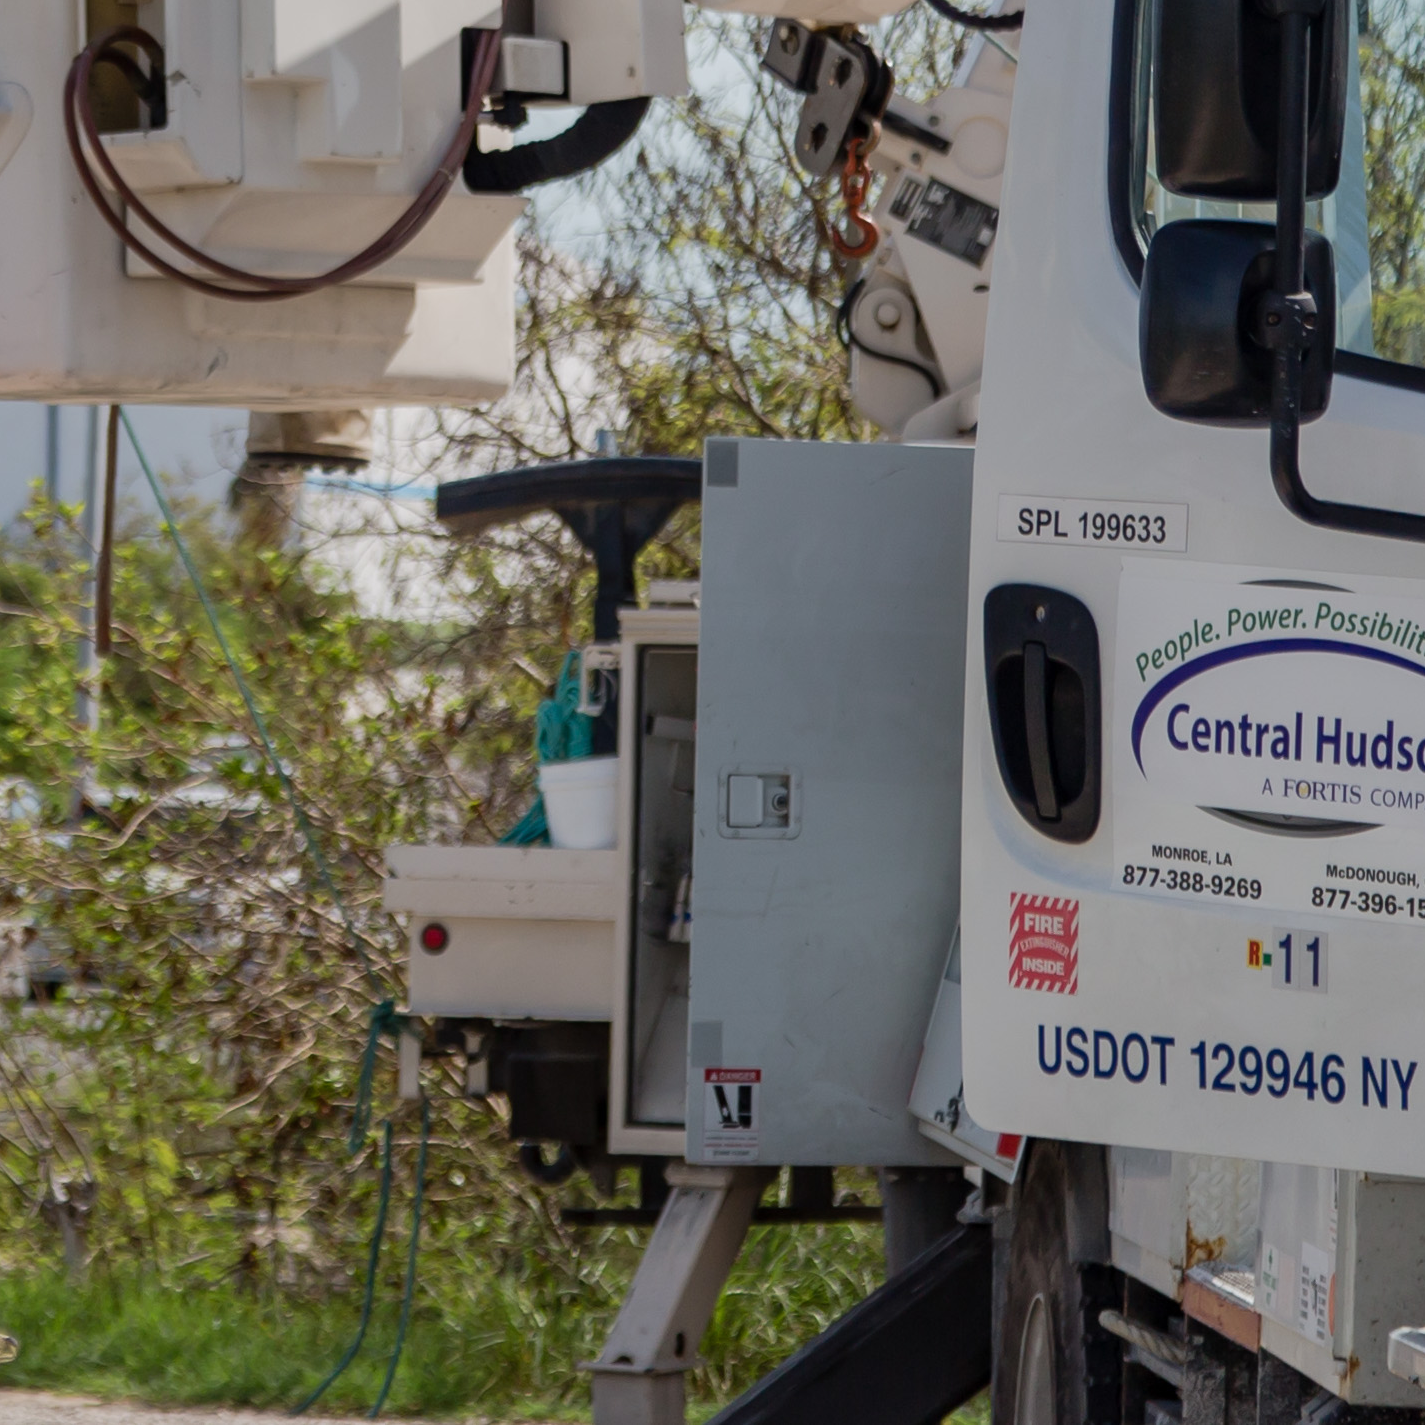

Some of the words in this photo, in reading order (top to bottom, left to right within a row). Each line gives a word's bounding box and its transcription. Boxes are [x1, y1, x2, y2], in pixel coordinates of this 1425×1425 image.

[1018, 508, 1068, 538] SPL
[1078, 511, 1166, 544] 199633
[1135, 619, 1221, 682] People.
[1227, 607, 1307, 637] Power.
[1166, 703, 1303, 762] Central
[1261, 778, 1274, 796] A
[1282, 778, 1363, 805] FORTIS
[1151, 844, 1212, 866] MONROE,
[1216, 852, 1233, 867] LA
[1122, 864, 1263, 900] 877-388-9269
[1325, 864, 1420, 890] McDONOUGH,
[1023, 912, 1065, 936] FIRE
[1022, 957, 1065, 976] INSIDE
[1037, 1024, 1176, 1087] USDOT
[1189, 1040, 1347, 1105] 129946
[1361, 1055, 1419, 1112] NY
